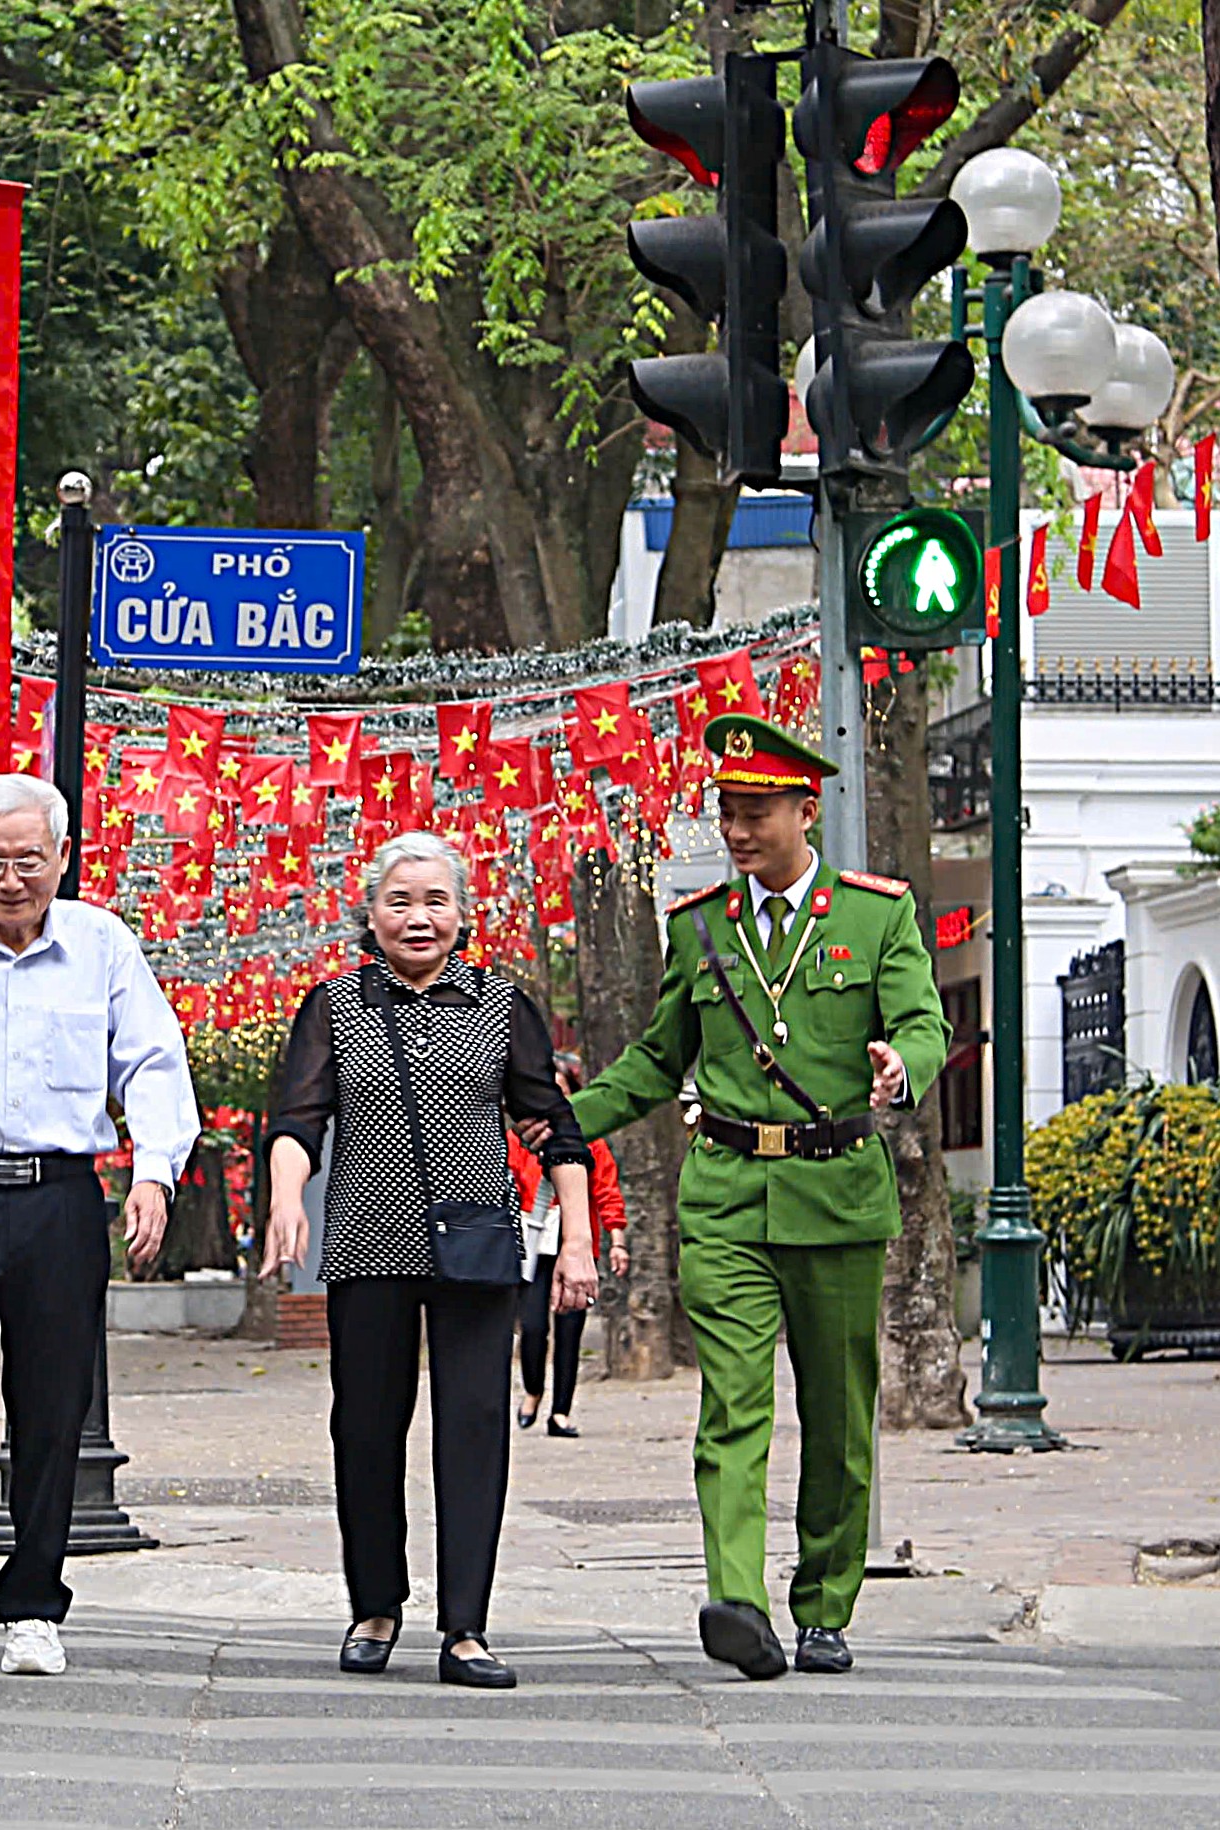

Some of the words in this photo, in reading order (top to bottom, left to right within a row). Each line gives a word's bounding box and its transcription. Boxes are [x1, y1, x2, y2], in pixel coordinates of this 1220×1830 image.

[212, 545, 294, 578] PHỐ
[117, 581, 214, 645] CỬA
[236, 587, 335, 649] BẮC
